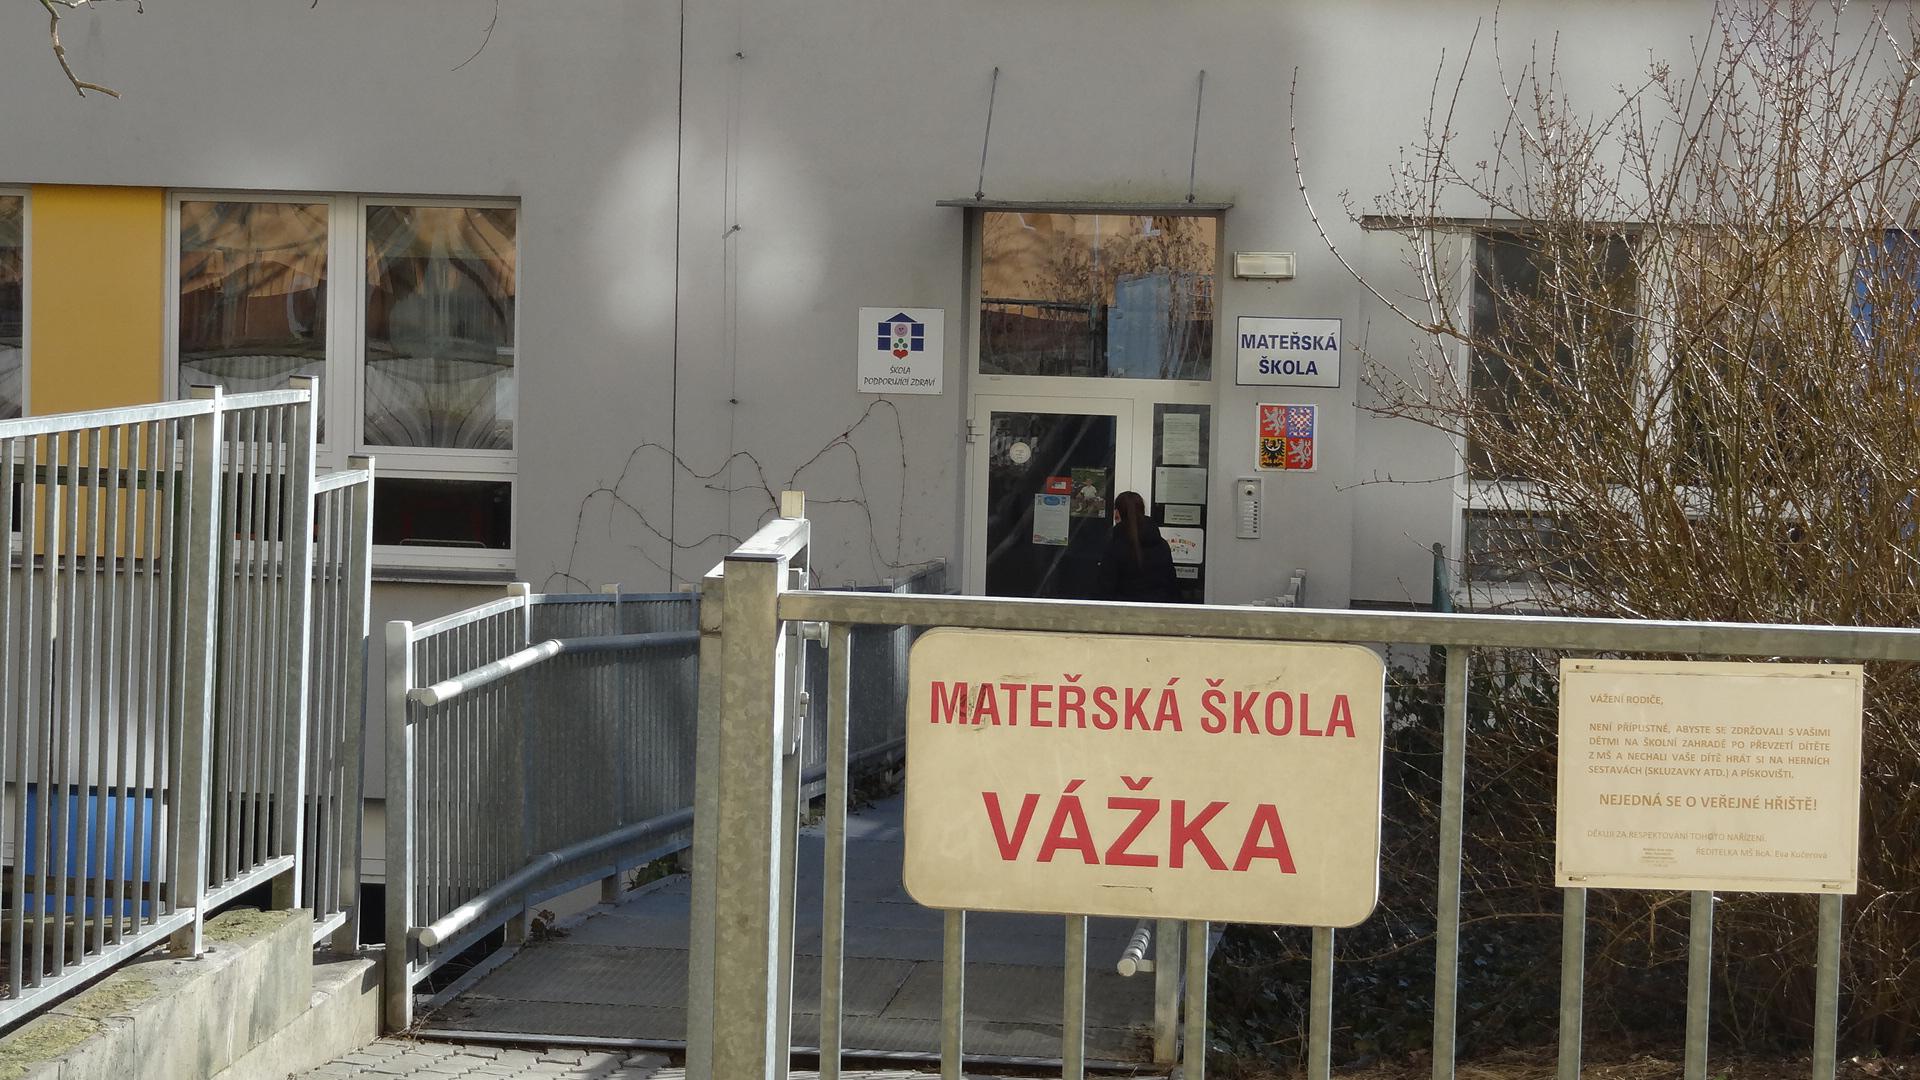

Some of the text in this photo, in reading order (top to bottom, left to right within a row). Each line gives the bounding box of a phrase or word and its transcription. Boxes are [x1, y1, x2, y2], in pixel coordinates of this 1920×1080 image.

[1241, 332, 1337, 351] MATEŘSKÁ
[890, 365, 911, 374] ŠKOLA
[1259, 356, 1319, 376] ŠKOLA
[911, 378, 936, 387] ZDRAVÍ
[930, 673, 1356, 738] MATEŘSKÁ ŠKOLA
[1590, 694, 1664, 706] VÁŽENÍ RODIČE,
[1589, 722, 1612, 732] NENÍ
[1676, 726, 1710, 734] ABYSTE
[1715, 726, 1726, 734] SE
[1731, 726, 1784, 736] ZDRŽOVALI
[1788, 727, 1794, 736] S
[1796, 727, 1831, 737] VAŠIMI
[1589, 737, 1831, 751] DĚTMI NA ŠKOLNÍ ZAHRADĚ PO PŘEVZETÍ DÍTĚTE
[1588, 750, 1830, 765] Z MŠ A NECHALI VAŠE DÍTĚ HRÁT SI NA HERNÍCH
[1588, 765, 1642, 775] SESTAVÁCH
[1644, 767, 1701, 777] (SKLUZAVKY
[1703, 769, 1728, 778] ATD.)
[1731, 768, 1738, 777] A
[1599, 793, 1818, 811] NEJEDNÁ SE O VEŘEJNÉ HŘIŠTĚ!
[981, 776, 1298, 874] VÁŽKA
[1616, 830, 1627, 838] ZA
[1690, 833, 1725, 841] TOHOTO
[1696, 847, 1738, 857] ŘEDITELKA
[1774, 850, 1789, 859] Eva
[1790, 850, 1828, 860] Kučerová
